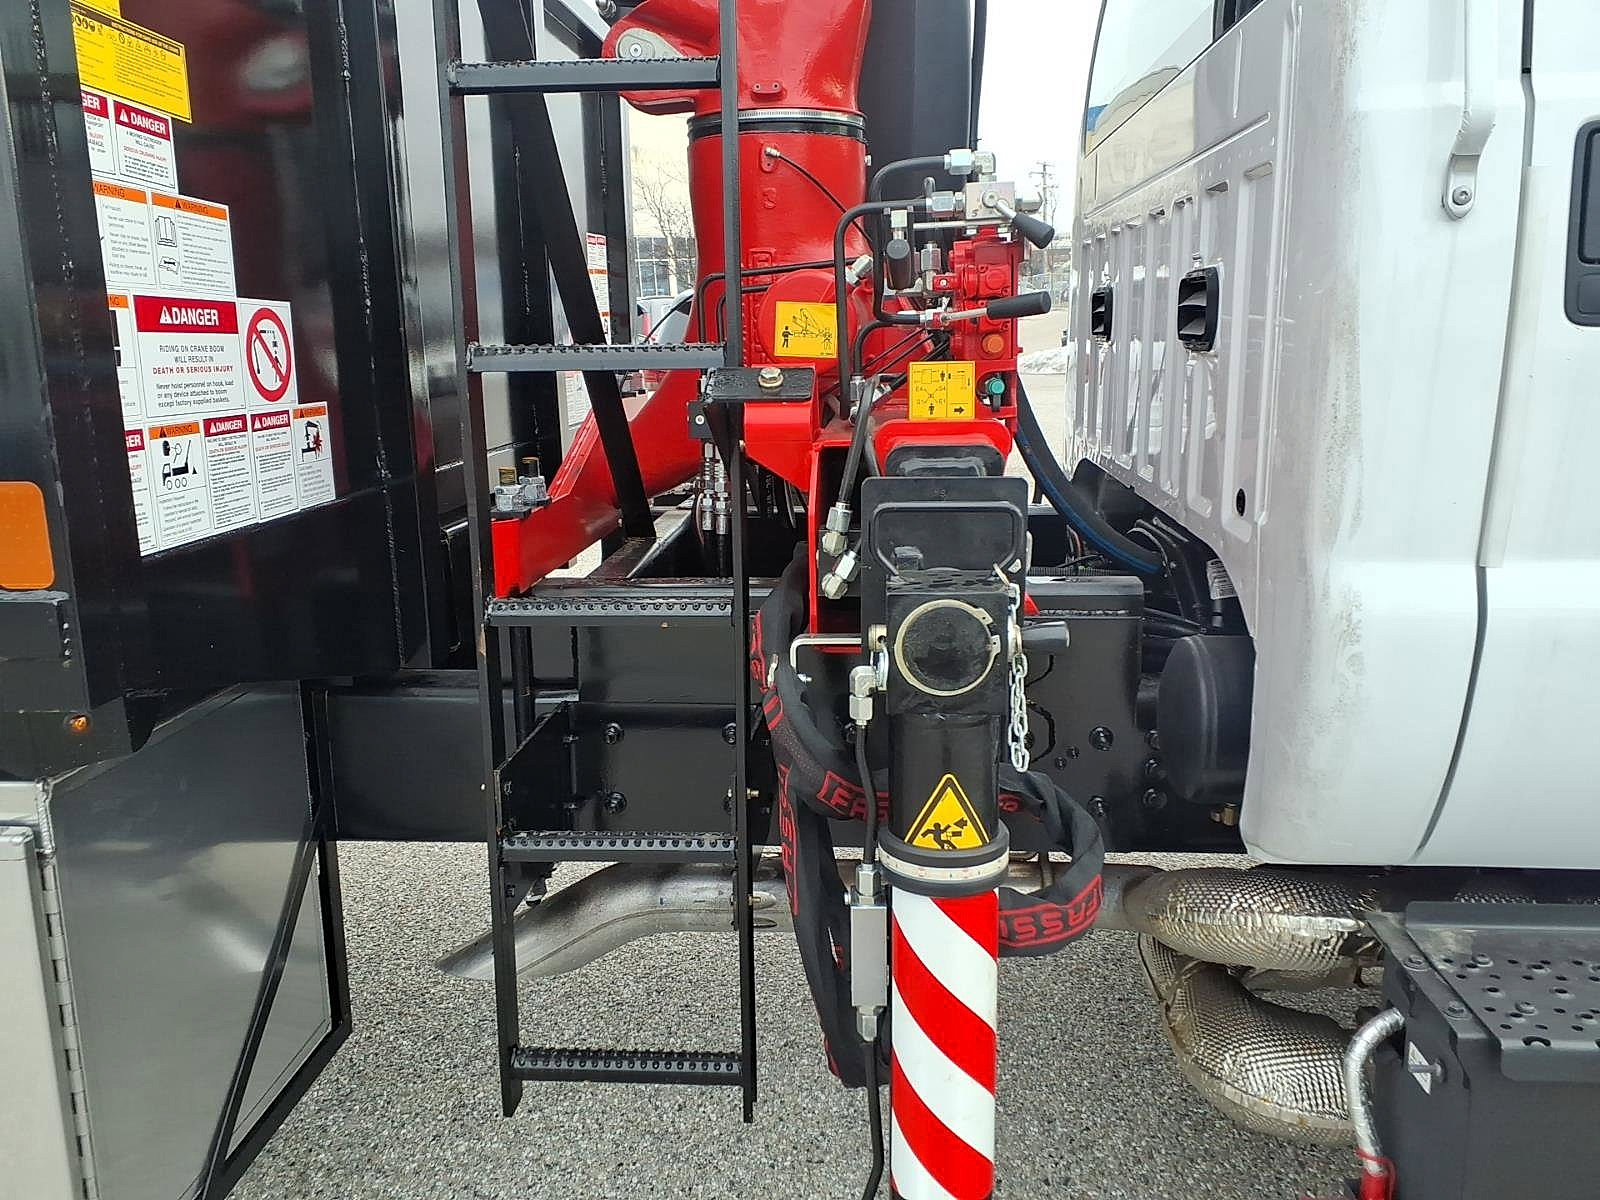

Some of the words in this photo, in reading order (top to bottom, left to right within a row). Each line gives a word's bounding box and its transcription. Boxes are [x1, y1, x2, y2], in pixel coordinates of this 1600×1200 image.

[81, 93, 100, 110] GER
[130, 112, 167, 135] DANGER
[172, 308, 219, 326] DANGER
[188, 355, 207, 363] RESULT
[187, 366, 212, 374] SERIOUS
[213, 365, 233, 373] INJURY
[216, 419, 242, 433] DANGER
[261, 413, 289, 428] DANGER
[167, 424, 193, 435] WARNING
